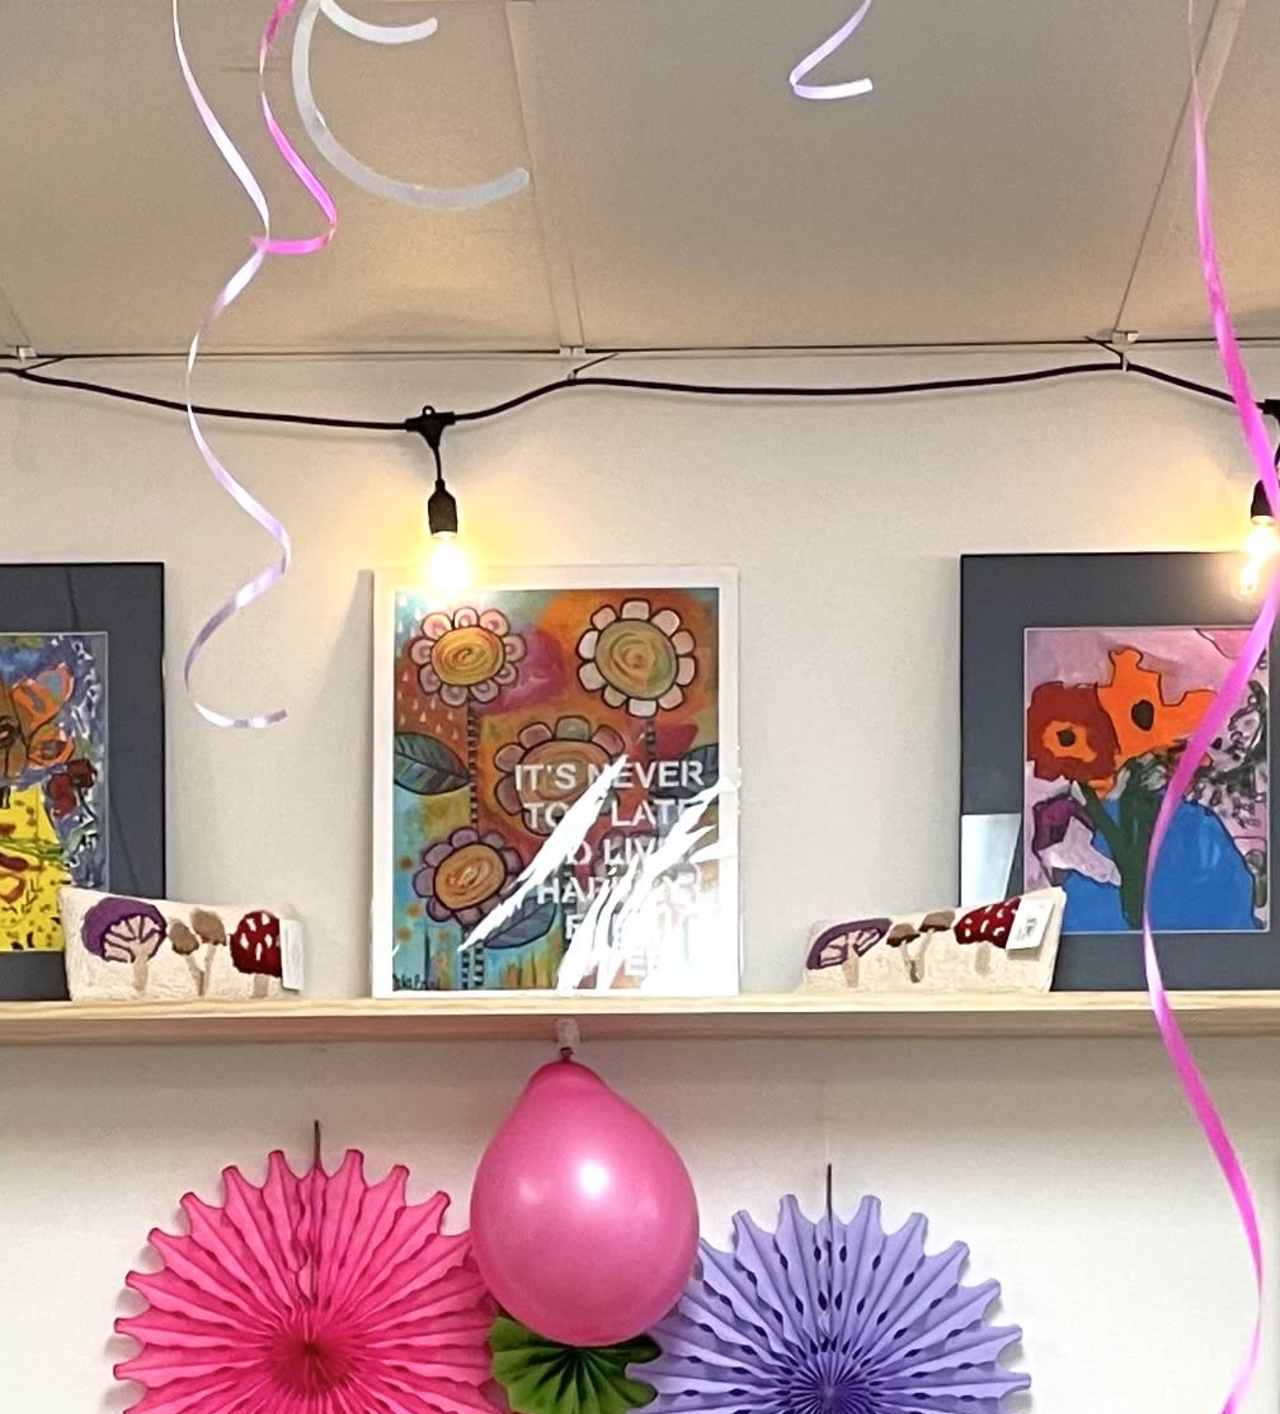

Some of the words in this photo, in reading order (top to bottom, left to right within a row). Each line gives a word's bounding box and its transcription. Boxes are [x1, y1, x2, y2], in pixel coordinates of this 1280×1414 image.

[514, 763, 578, 791] IT'S
[588, 760, 705, 790] NEVER
[603, 838, 666, 866] LIV
